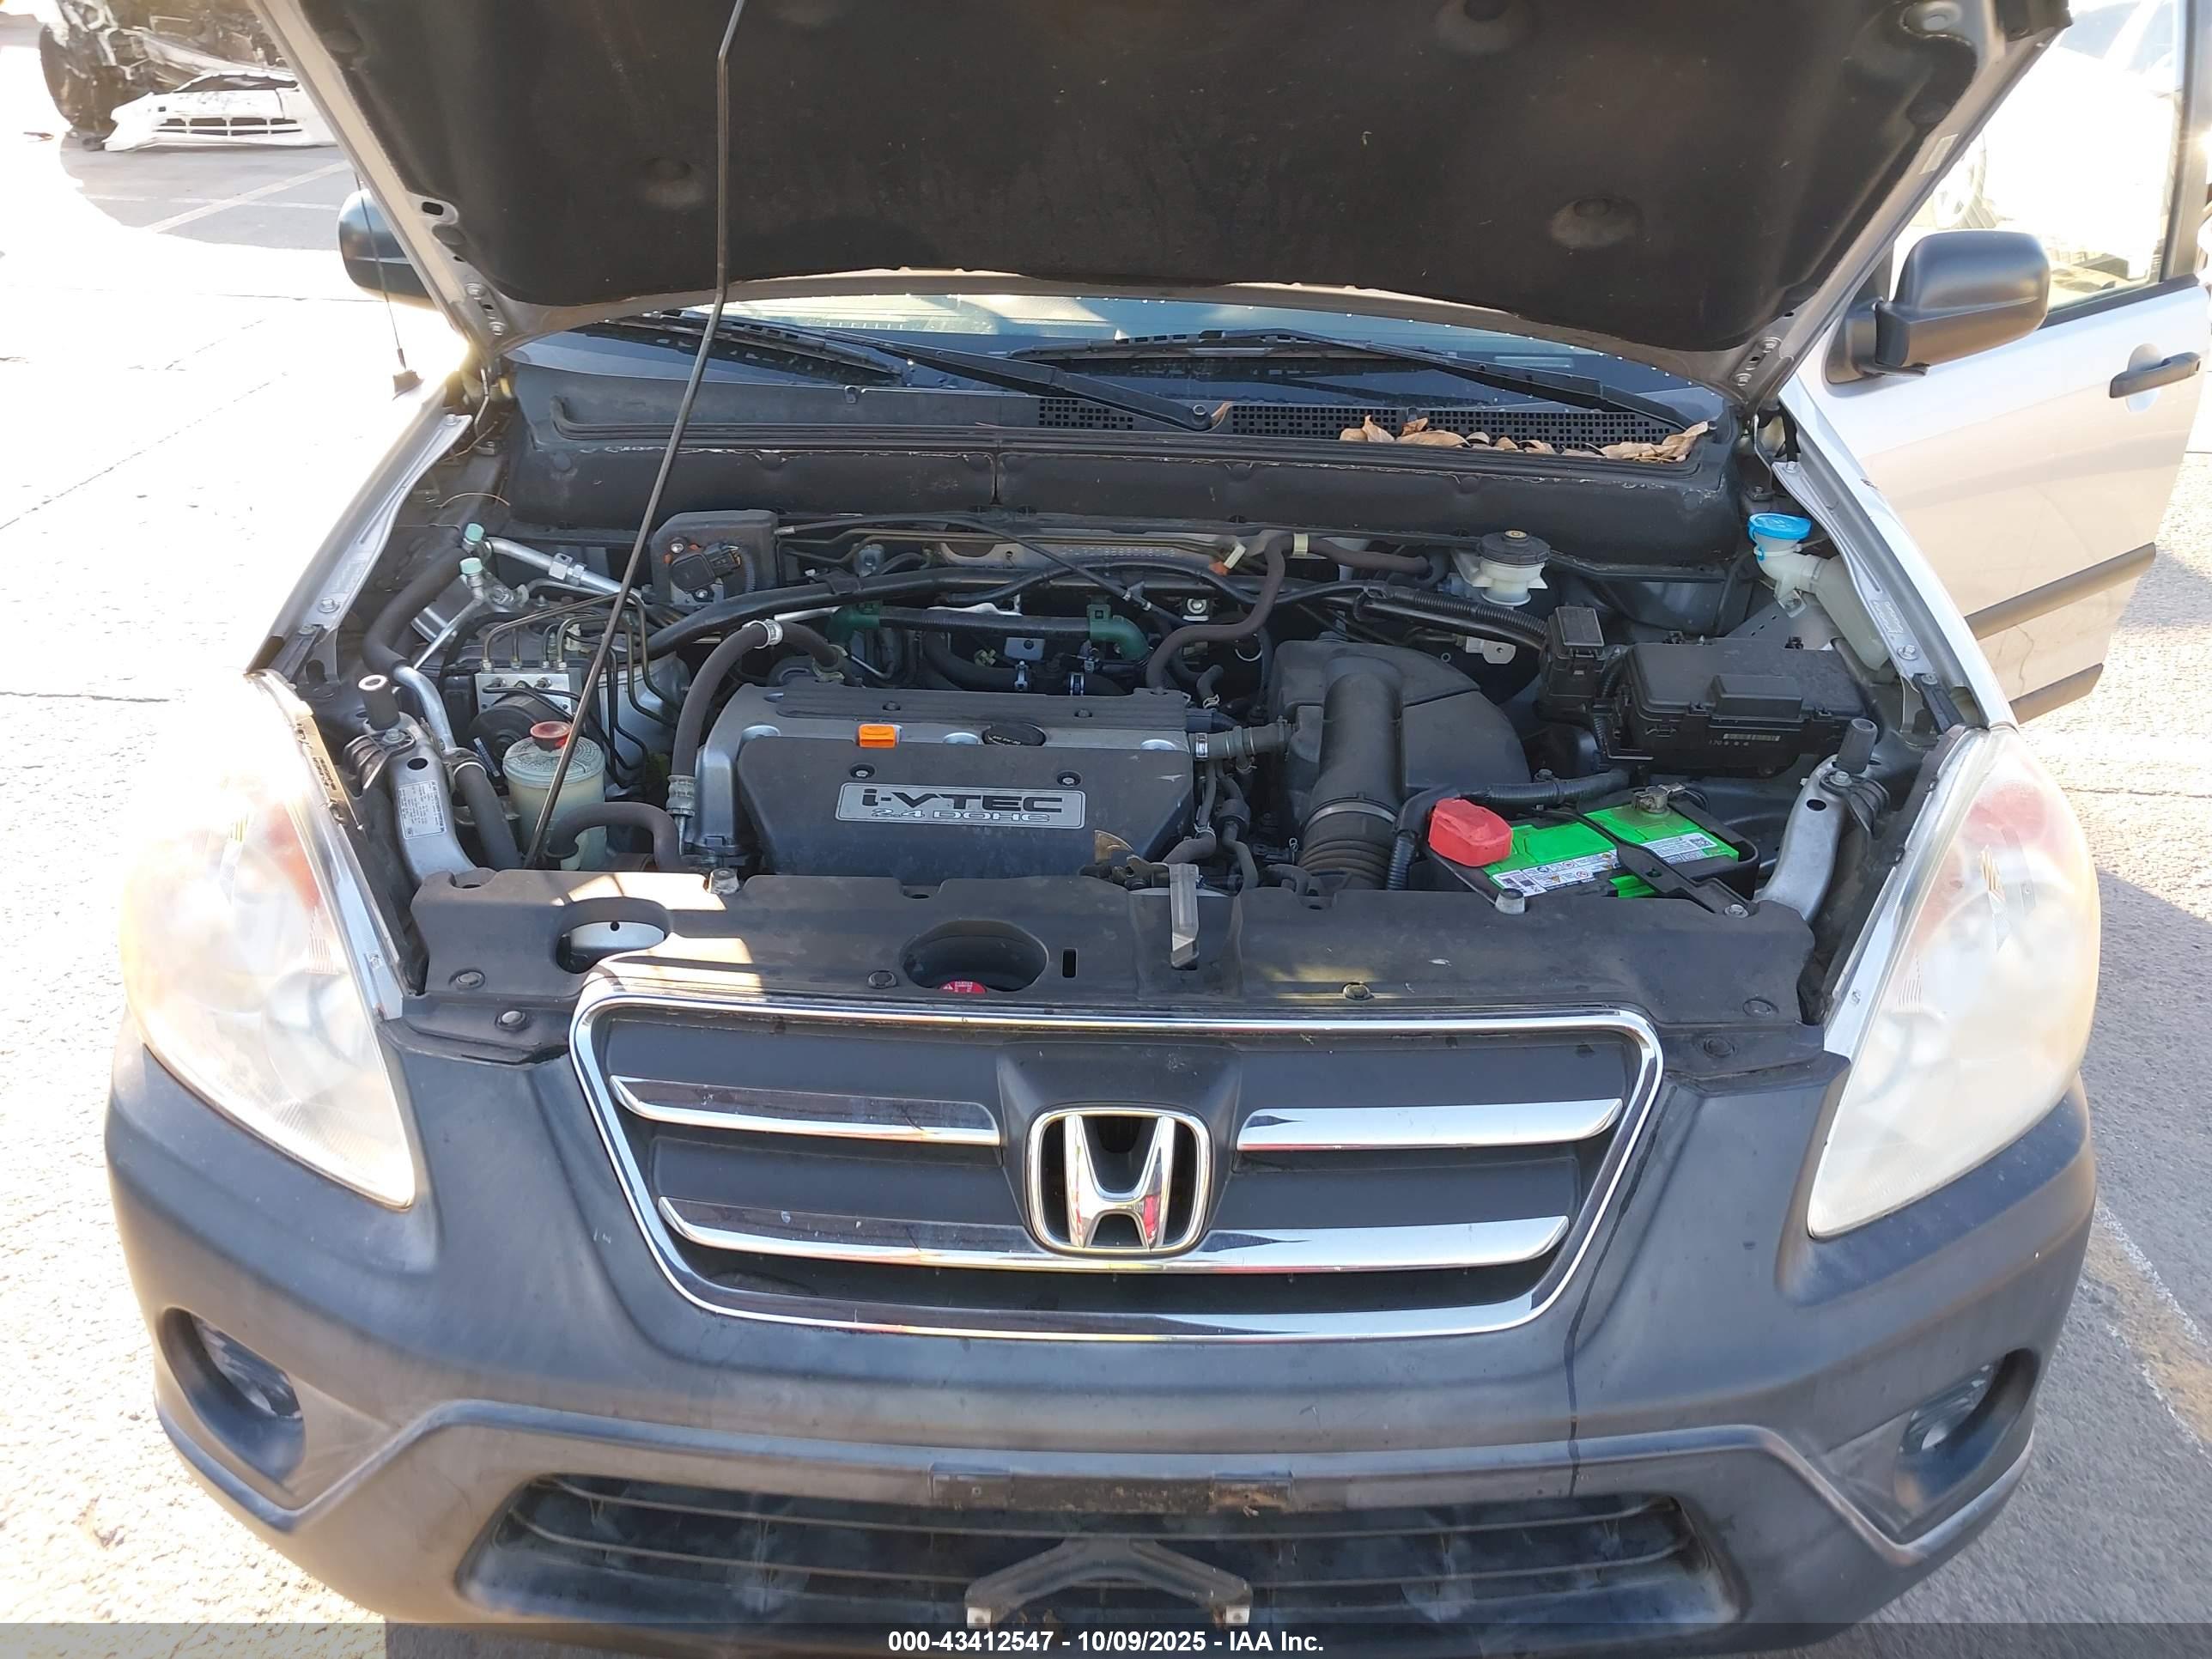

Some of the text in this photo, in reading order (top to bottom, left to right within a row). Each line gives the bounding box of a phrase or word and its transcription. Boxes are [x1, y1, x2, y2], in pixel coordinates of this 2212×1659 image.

[862, 788, 1063, 813] i-VTEC
[872, 807, 1051, 823] 2.4 DOHC
